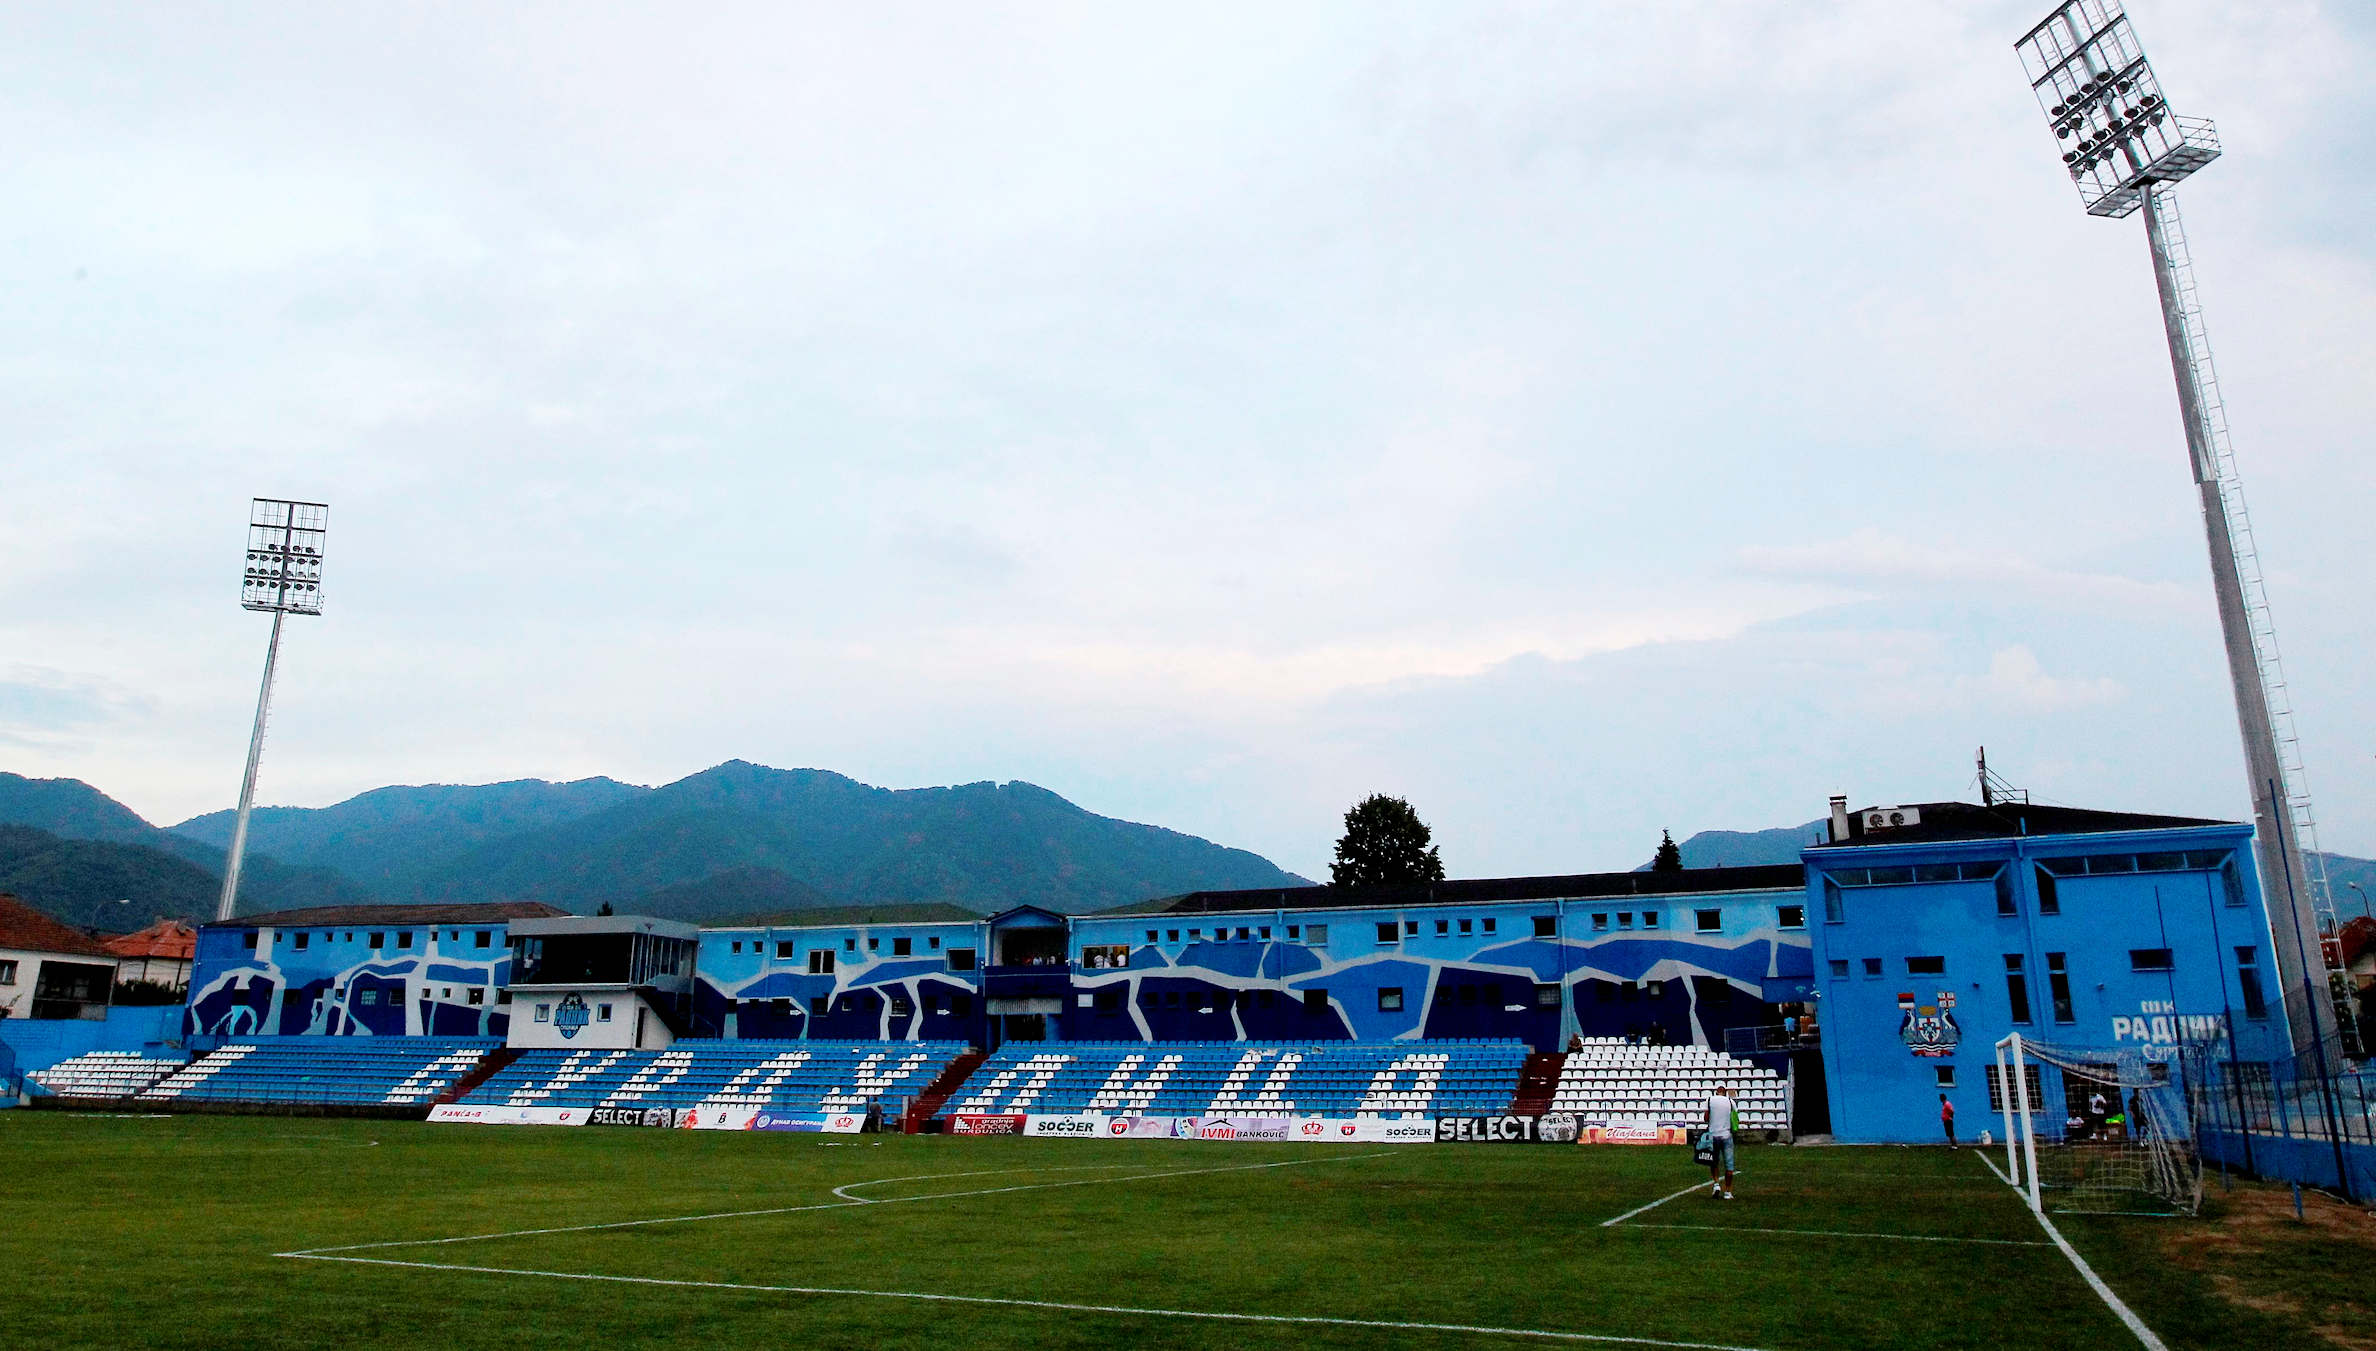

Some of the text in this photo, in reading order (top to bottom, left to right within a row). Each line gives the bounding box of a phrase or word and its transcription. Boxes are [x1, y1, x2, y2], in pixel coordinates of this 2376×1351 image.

[2112, 1015, 2230, 1044] РАДНИК
[594, 1109, 642, 1124] SELECT
[1548, 1117, 1574, 1125] SELECT
[1037, 1121, 1094, 1132] SOCCER
[1386, 1128, 1431, 1136] SOCCER
[1439, 1115, 1533, 1141] SELECT
[1201, 1128, 1235, 1139] IVMI
